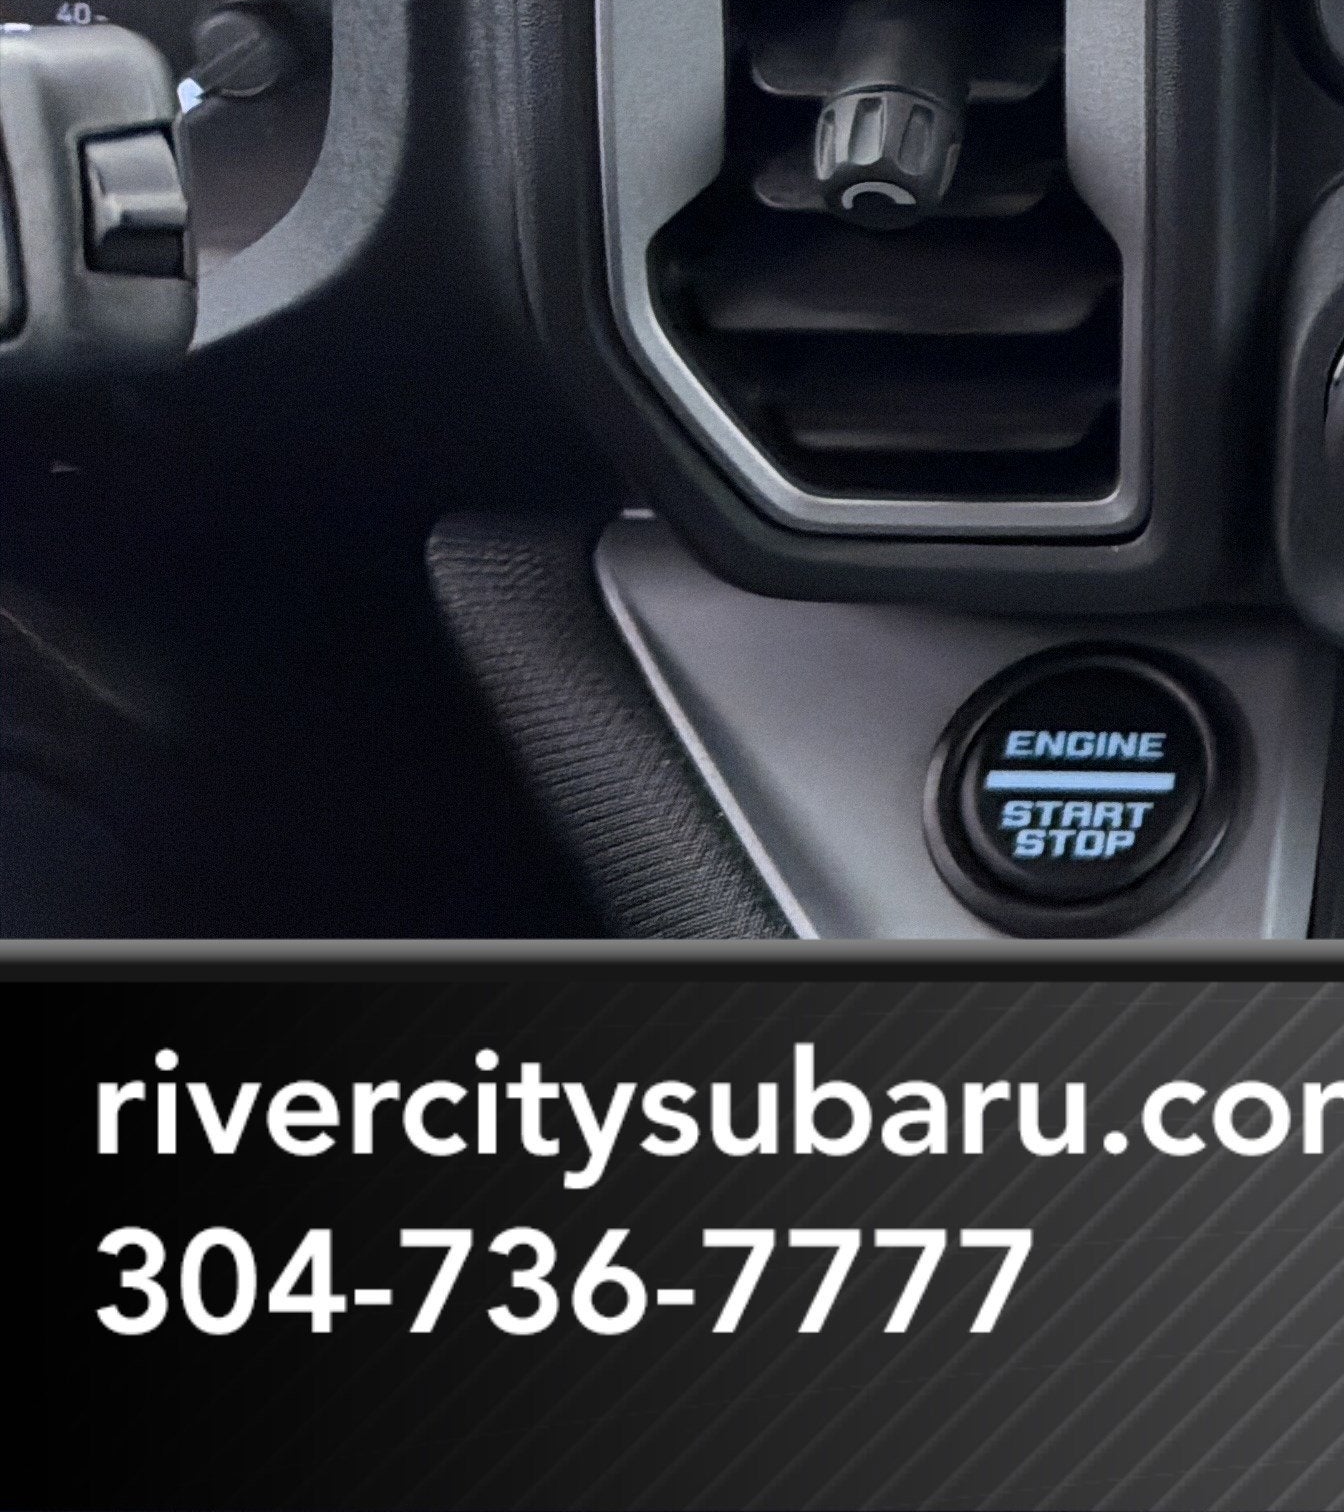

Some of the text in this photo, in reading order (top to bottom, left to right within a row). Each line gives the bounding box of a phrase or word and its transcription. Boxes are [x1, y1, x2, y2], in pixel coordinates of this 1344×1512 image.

[56, 2, 90, 25] 40
[1004, 730, 1168, 760] ENGINE
[1002, 800, 1155, 830] START
[1014, 829, 1136, 859] STOP
